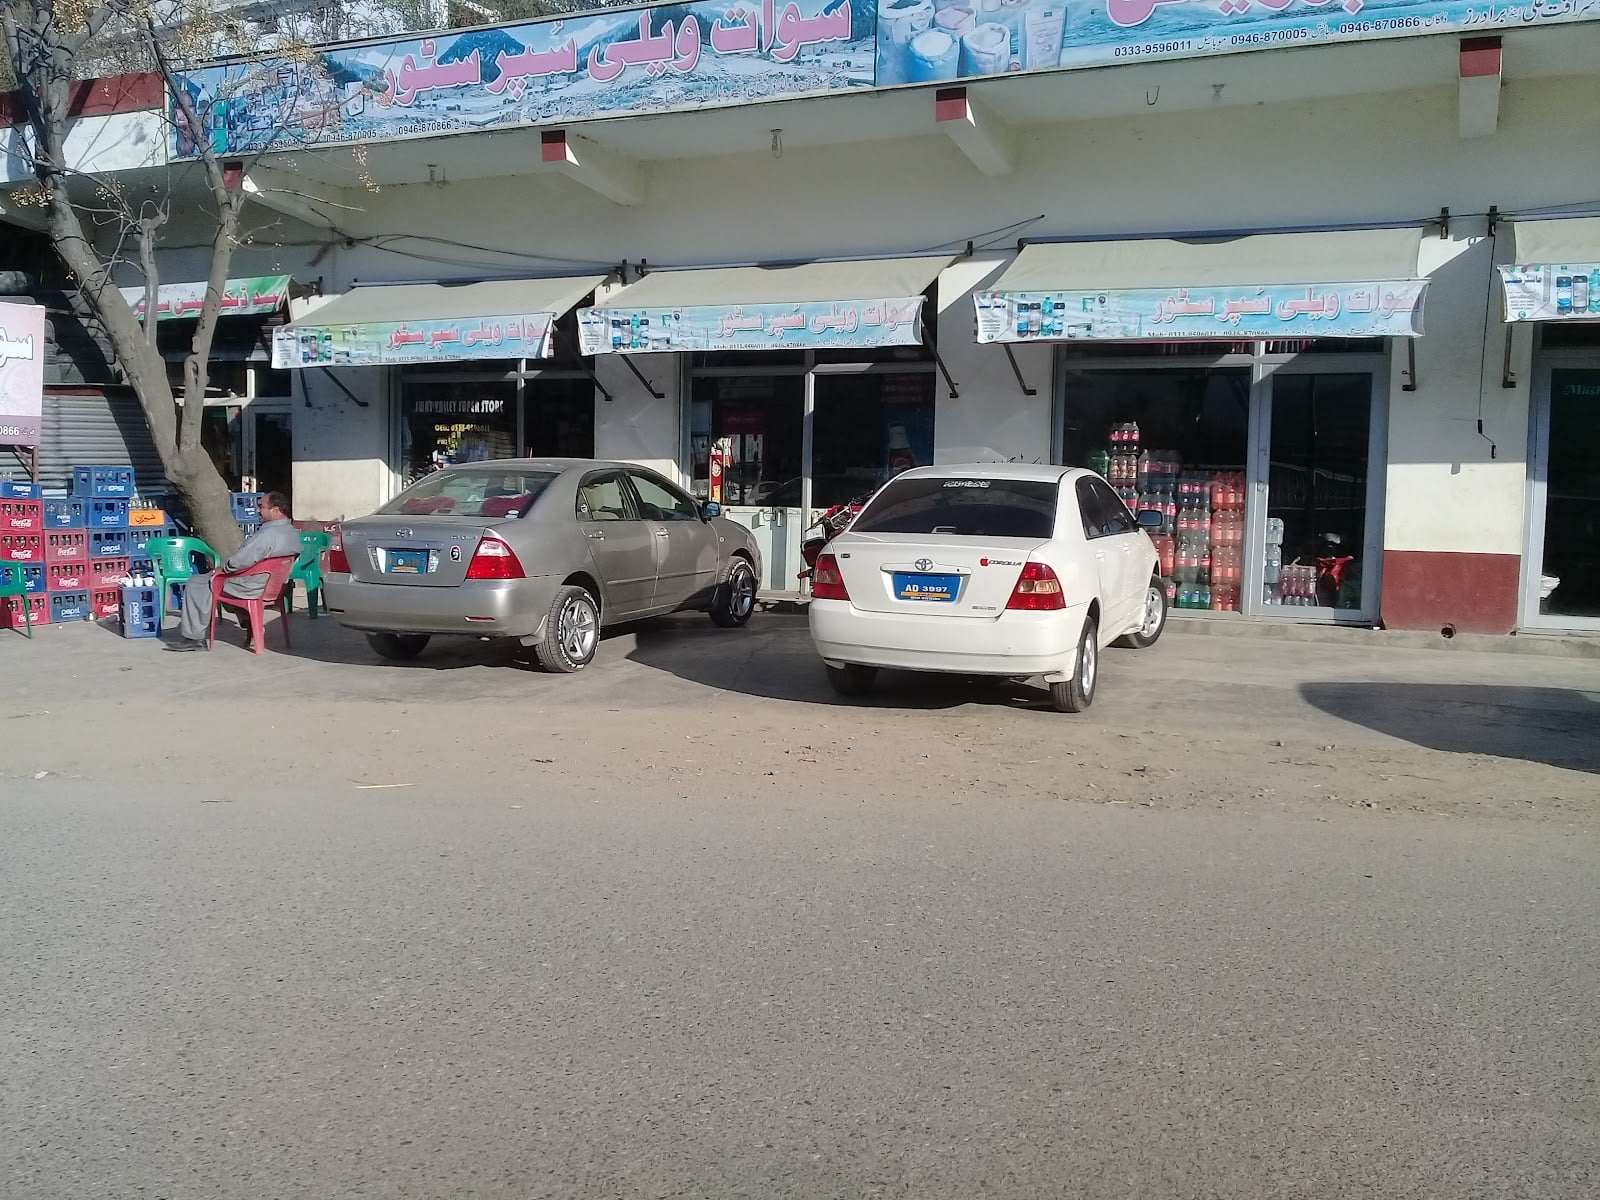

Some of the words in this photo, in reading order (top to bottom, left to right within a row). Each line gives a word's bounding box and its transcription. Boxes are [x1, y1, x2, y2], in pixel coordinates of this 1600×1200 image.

[710, 0, 852, 61] سوات
[1340, 17, 1420, 34] 0946-870866
[588, 8, 702, 83] ویلی
[1231, 28, 1308, 46] 0946-870005
[1114, 39, 1192, 57] 0333-9596011
[376, 38, 481, 107] سٹور
[398, 120, 452, 136] 0946-870866
[1275, 285, 1340, 326] ویلی
[481, 400, 504, 413] STORE
[905, 584, 919, 592] AD
[61, 607, 81, 616] pepsi
